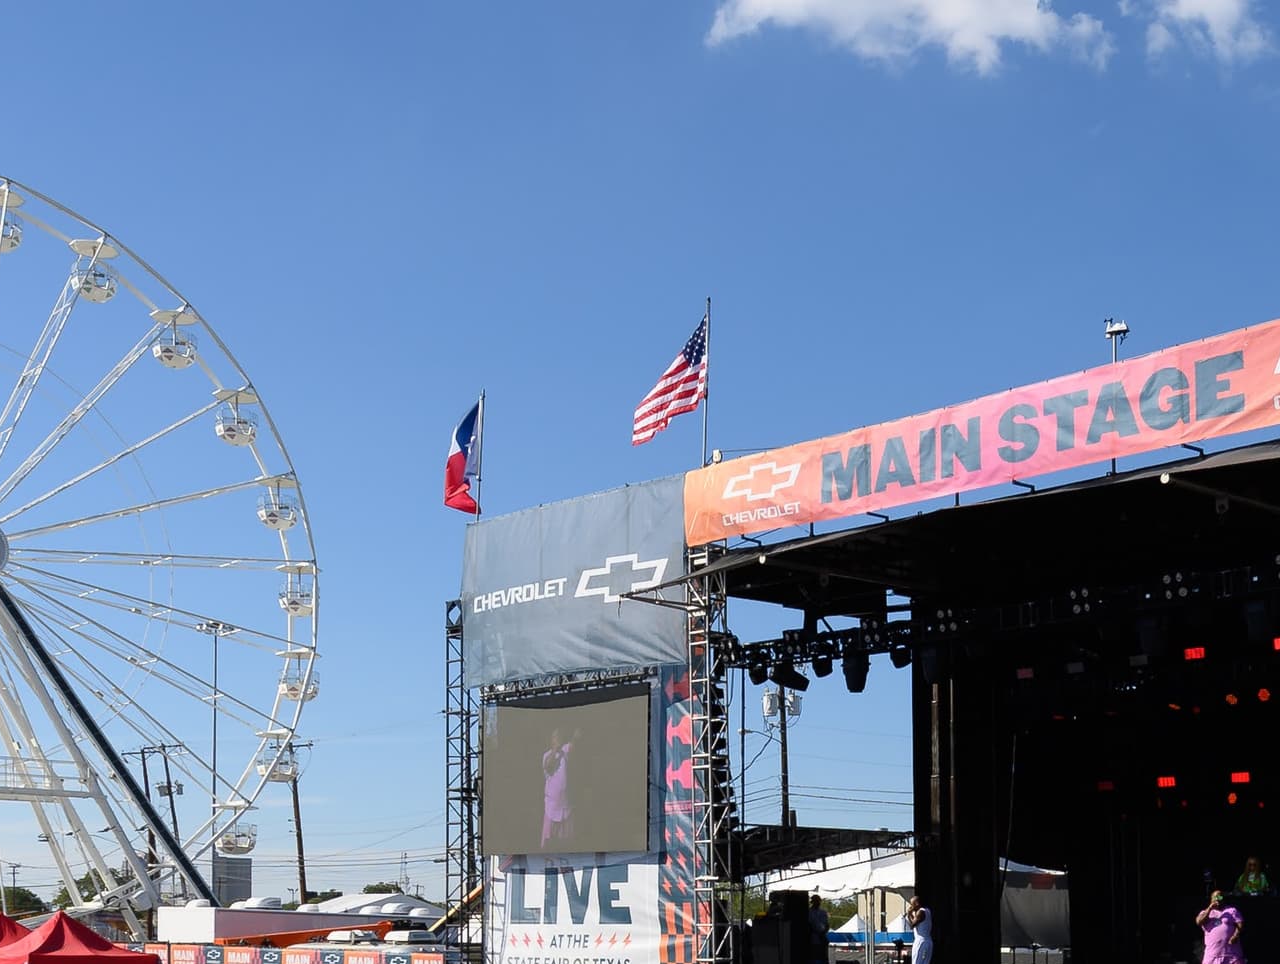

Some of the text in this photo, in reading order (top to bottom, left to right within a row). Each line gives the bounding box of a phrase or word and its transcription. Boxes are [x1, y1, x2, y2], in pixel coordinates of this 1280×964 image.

[820, 349, 1245, 503] MAIN STAGE
[722, 501, 802, 527] CHEVROLET
[473, 577, 568, 614] CHEVROLET
[510, 863, 633, 925] LIVE
[549, 934, 590, 950] AT THE
[174, 950, 195, 961] MAIN
[227, 952, 250, 964] MAIN
